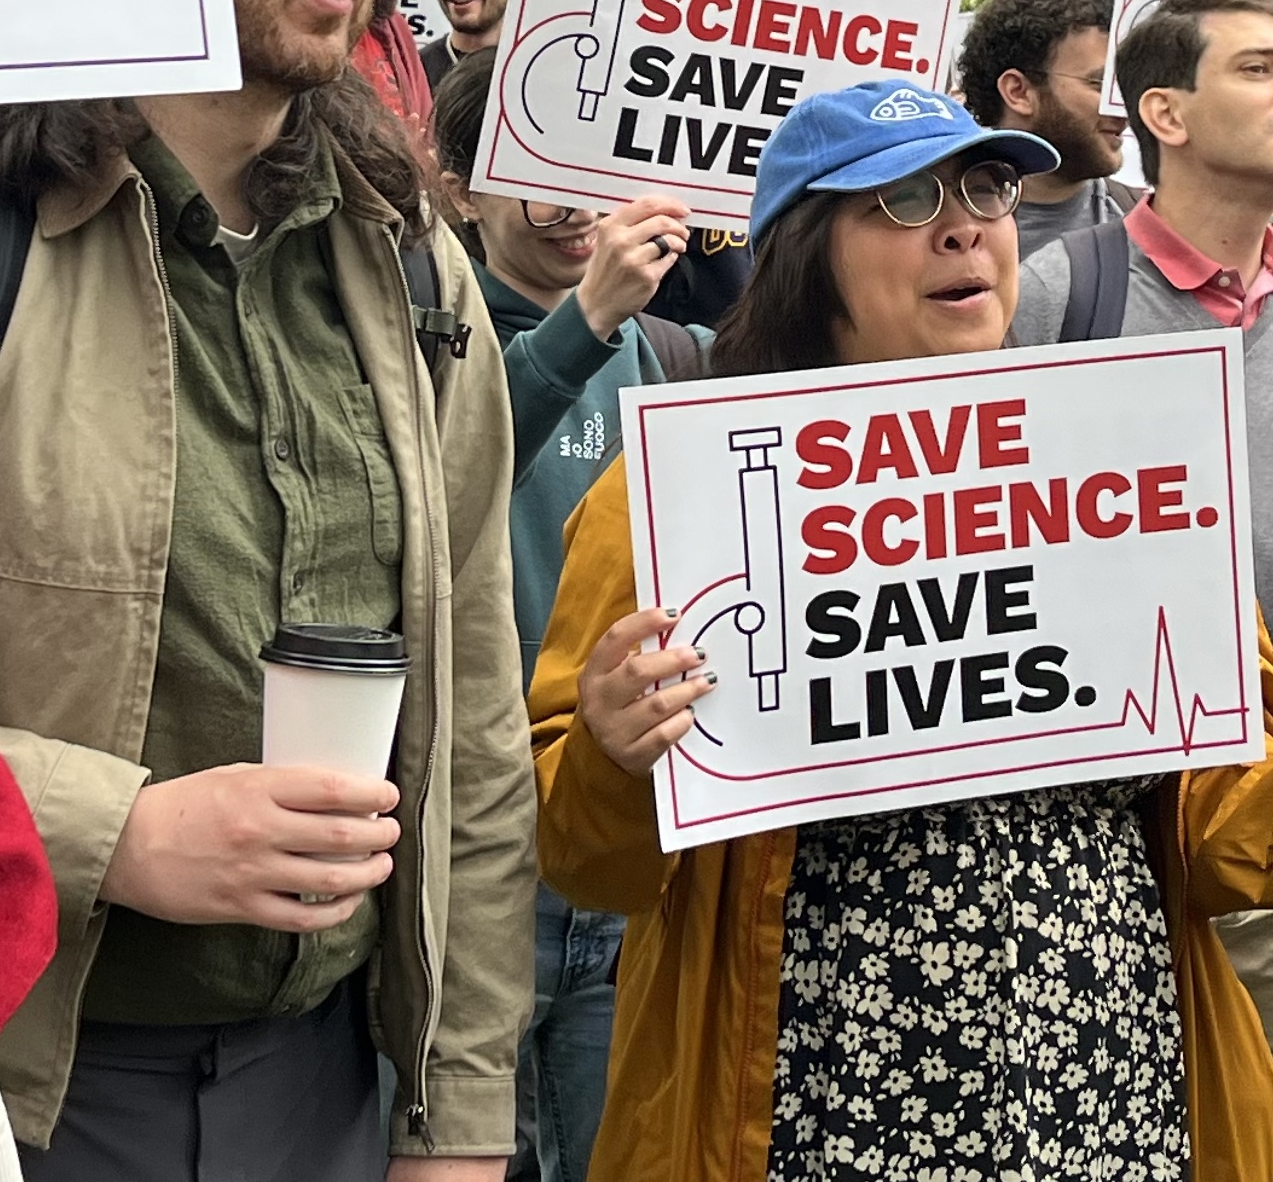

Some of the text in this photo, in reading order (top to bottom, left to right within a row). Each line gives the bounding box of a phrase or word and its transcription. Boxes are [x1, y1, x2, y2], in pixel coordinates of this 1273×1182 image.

[624, 45, 804, 117] SAVE
[612, 107, 771, 177] LIVE
[560, 435, 571, 457] MA
[583, 420, 594, 459] SONO
[796, 399, 1029, 490] SAVE
[801, 465, 1219, 575] SCIENCE.
[805, 565, 1037, 659] SAVE
[809, 645, 1097, 745] LIVES.
